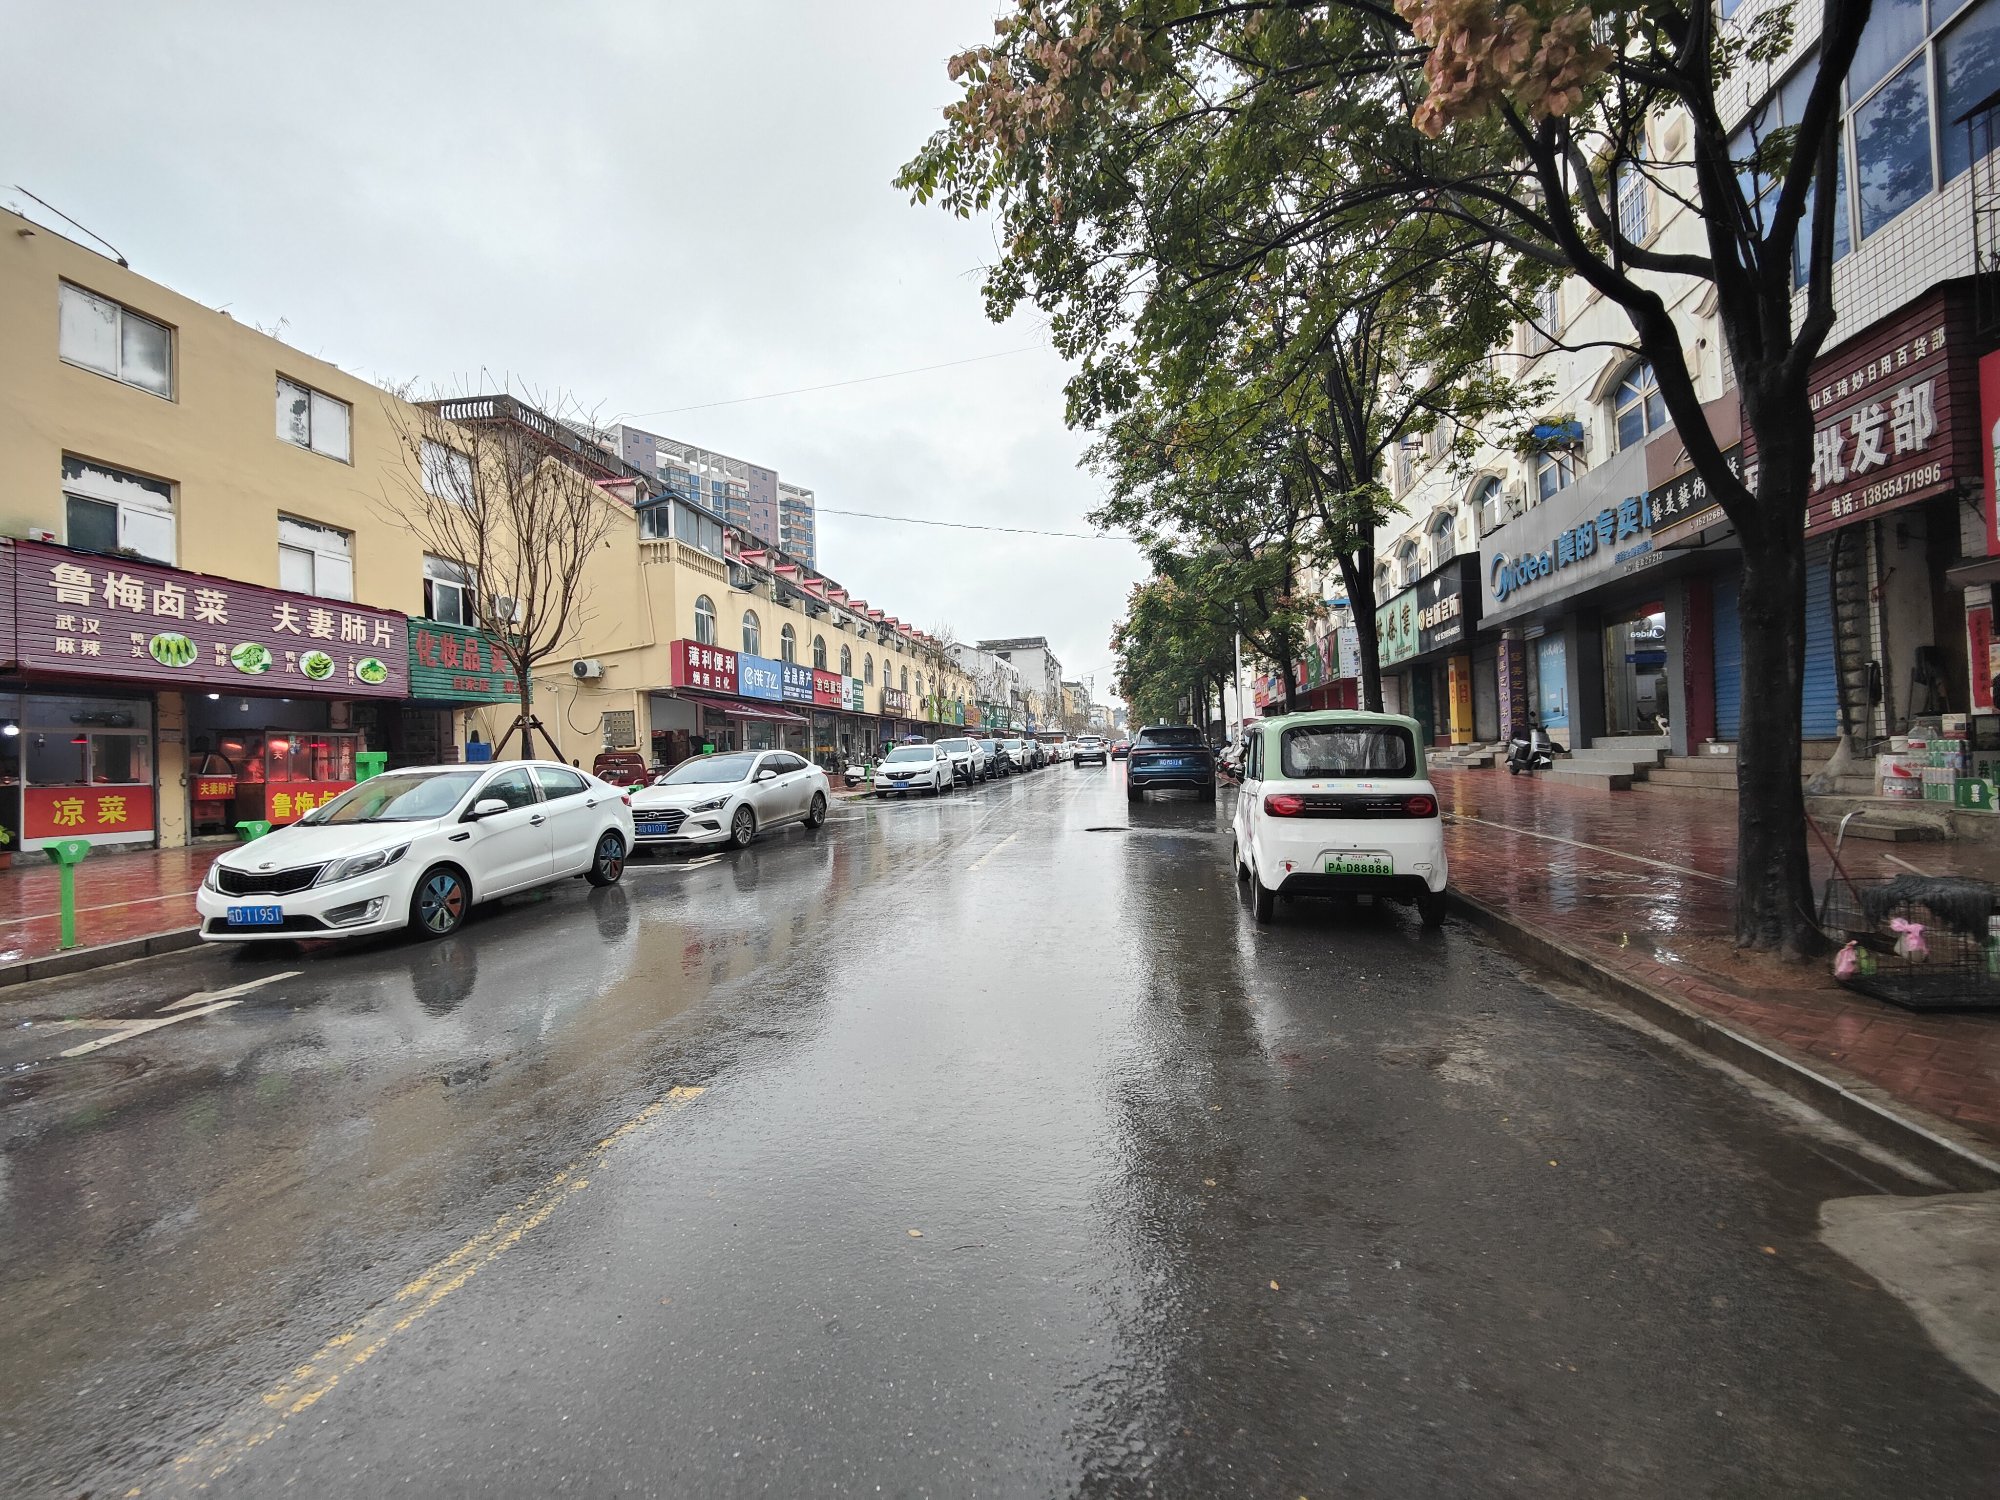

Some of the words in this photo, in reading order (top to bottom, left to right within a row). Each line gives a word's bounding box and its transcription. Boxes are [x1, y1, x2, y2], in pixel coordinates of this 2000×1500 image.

[1811, 380, 1938, 493] 批发部
[1490, 549, 1554, 602] Midea
[48, 562, 230, 625] 鲁梅卤菜
[271, 601, 395, 649] 夫妻肺片
[55, 613, 101, 636] 武汉
[54, 636, 101, 657] 麻辣
[130, 632, 145, 659] 鸭头
[200, 782, 236, 796] 夫妻肺片
[52, 795, 128, 827] 凉菜
[271, 790, 354, 819] 鲁梅卤
